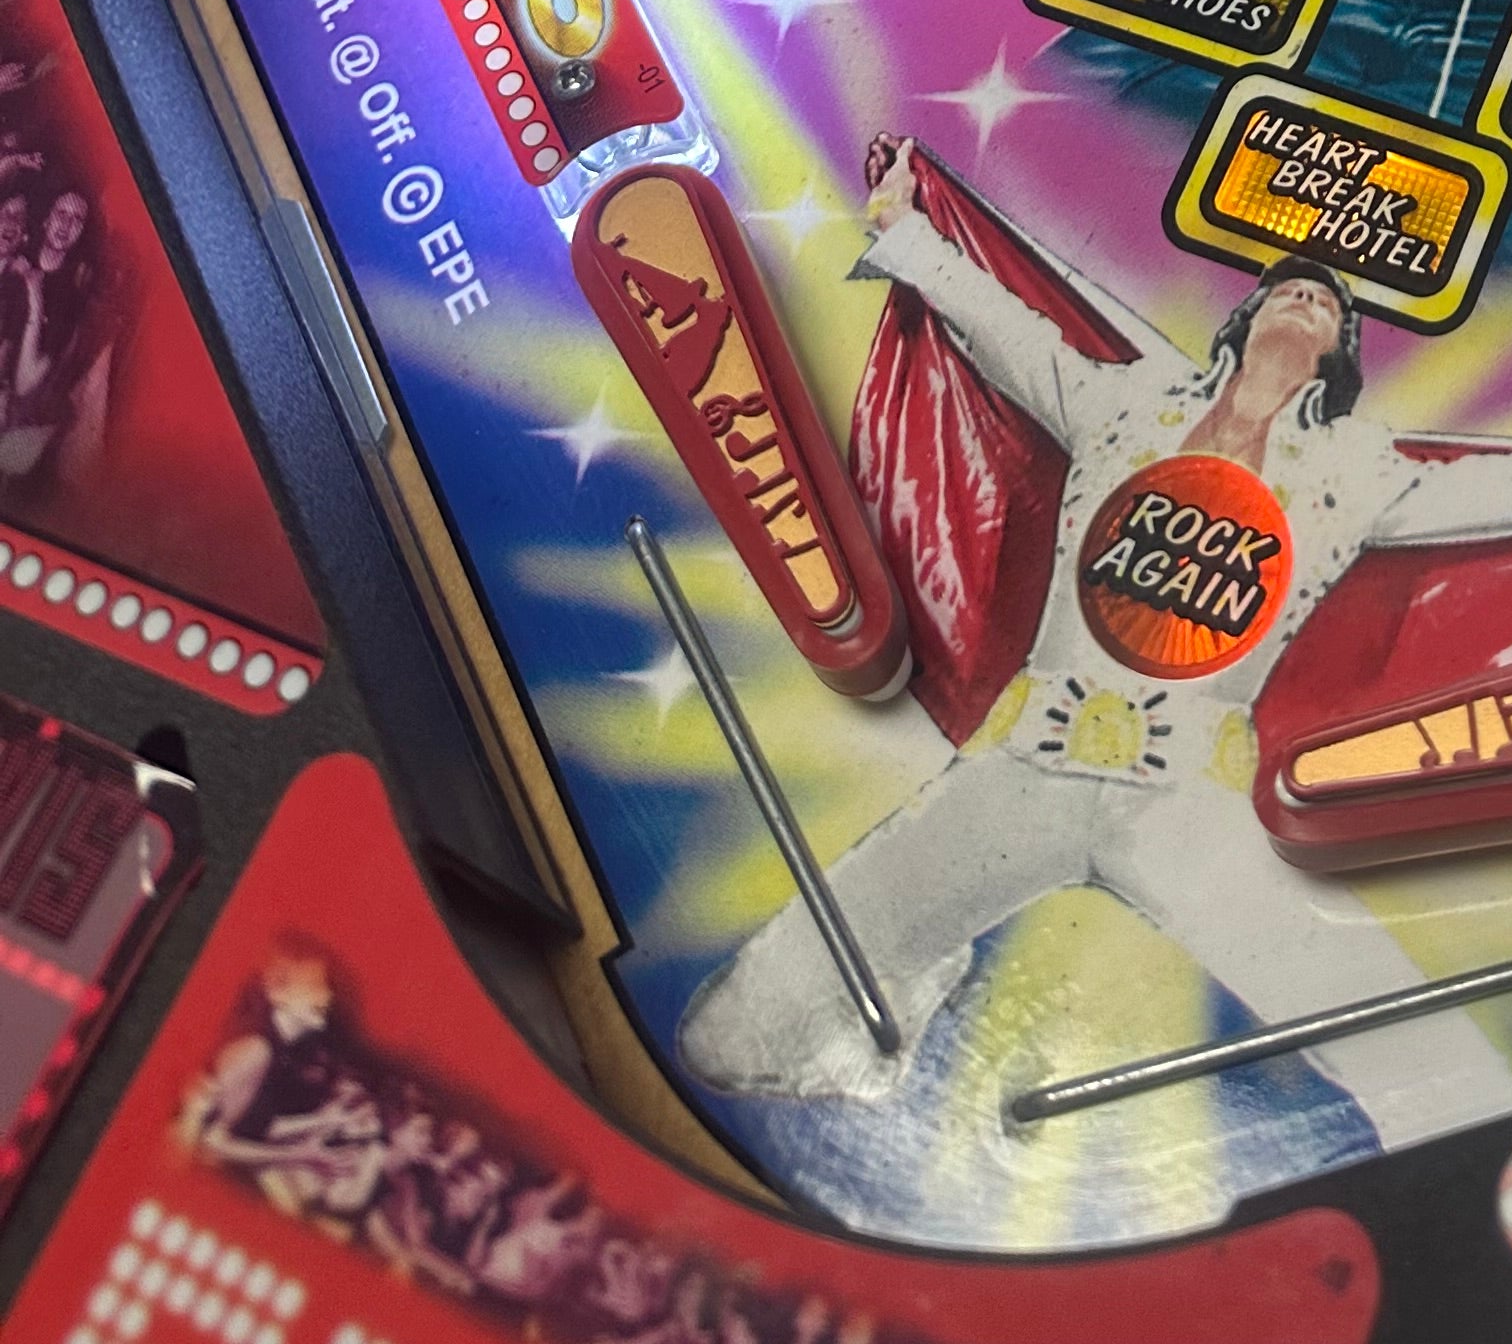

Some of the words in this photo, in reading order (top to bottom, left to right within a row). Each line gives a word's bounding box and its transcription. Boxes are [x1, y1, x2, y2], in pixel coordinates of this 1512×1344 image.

[1248, 113, 1380, 176] HEART
[358, 81, 417, 164] Off.
[417, 219, 491, 325] EPE
[1272, 159, 1412, 226] BREAK
[1311, 208, 1442, 275] HOTEL
[1130, 493, 1276, 572] ROCK
[1092, 537, 1262, 623] AGAIN
